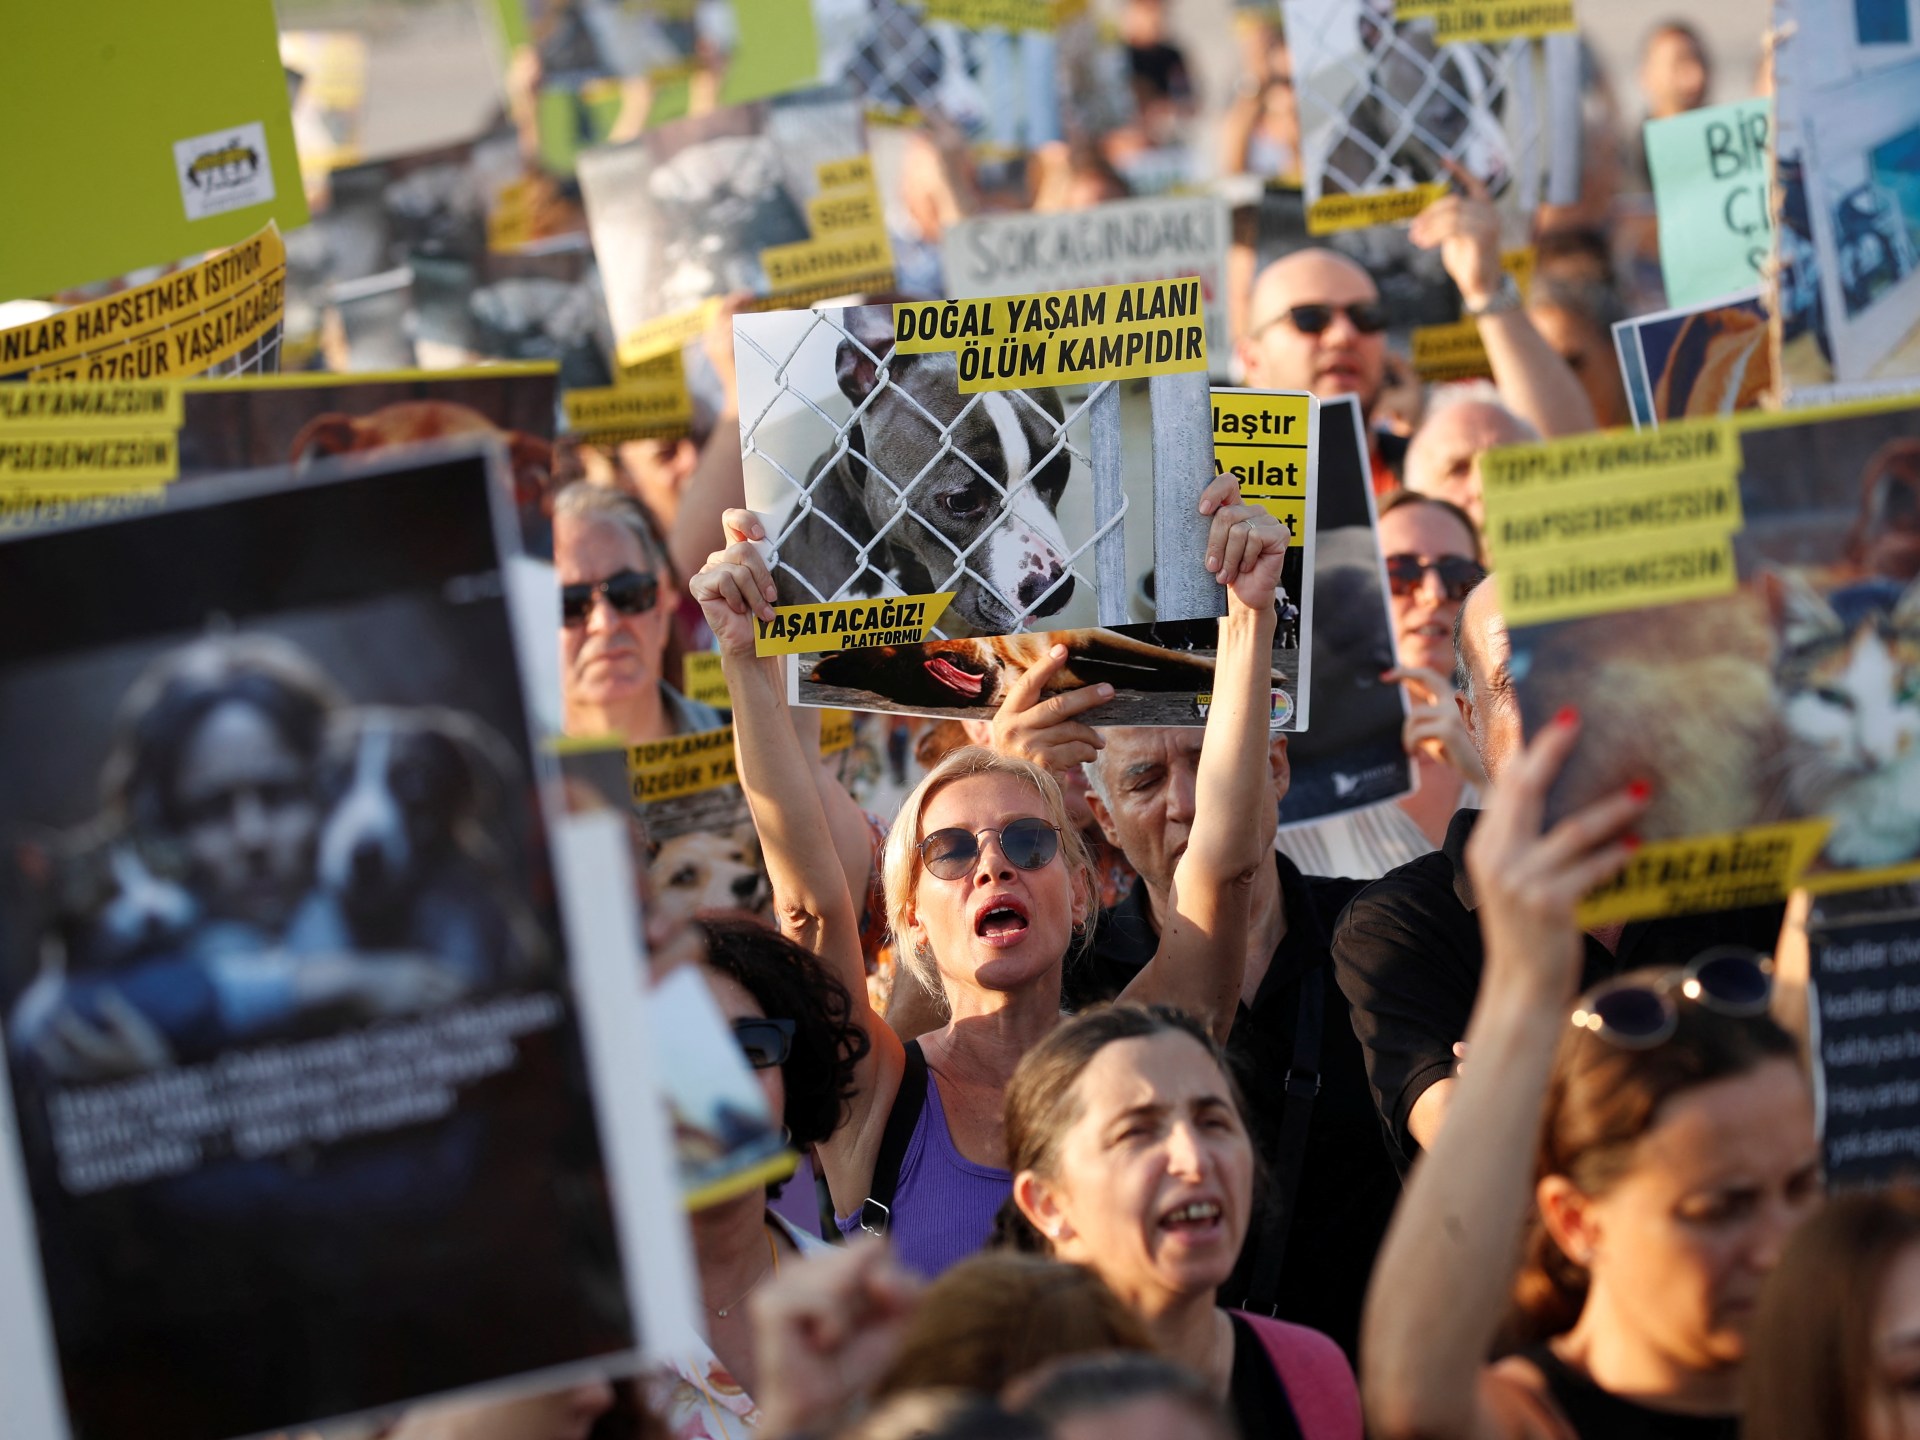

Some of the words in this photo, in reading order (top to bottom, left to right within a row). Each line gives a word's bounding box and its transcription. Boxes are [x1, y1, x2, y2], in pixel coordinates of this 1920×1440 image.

[0, 320, 67, 363] NLAR
[76, 271, 199, 343] HAPSETMEK
[204, 240, 262, 297] İSTİYOR
[895, 298, 995, 342] DOĞAL
[1007, 291, 1107, 339] YAŞAM
[1115, 281, 1199, 324] ALANI
[959, 335, 1047, 382] ÖLÜM
[1057, 326, 1203, 373] KAMPIDIR
[757, 599, 926, 643] YAŞATACAĞIZ!
[841, 628, 922, 649] PLATFORMU
